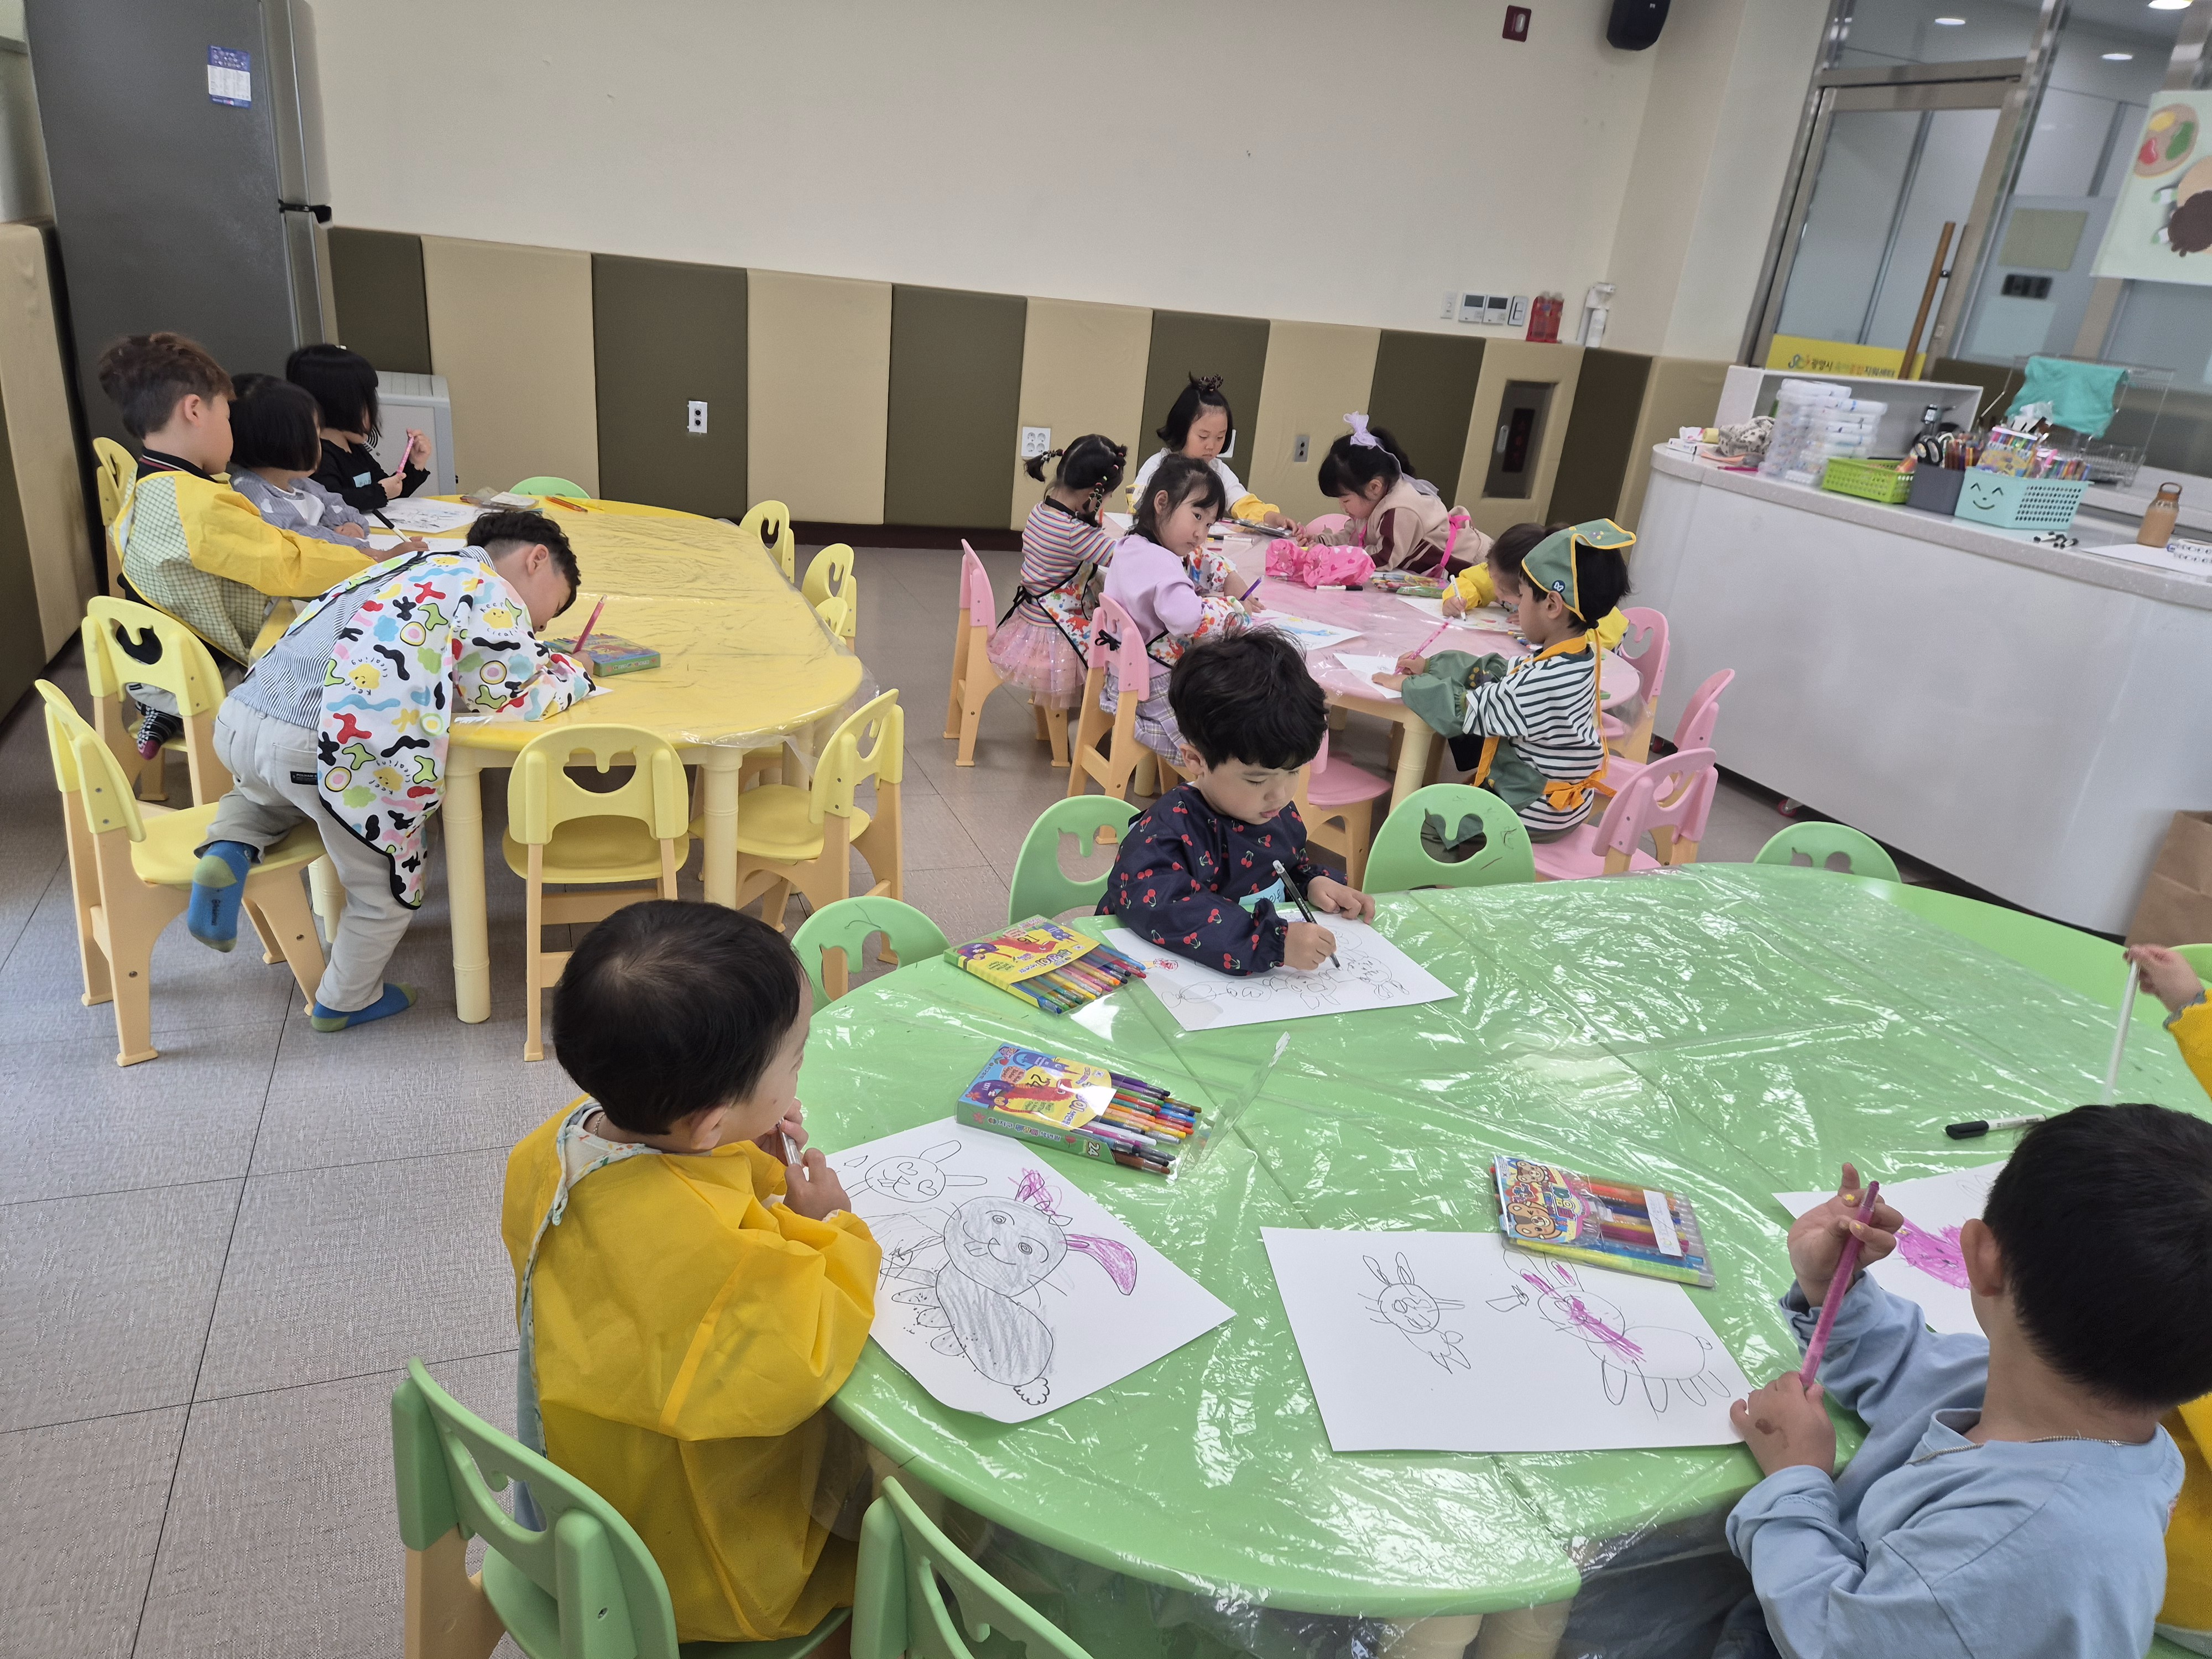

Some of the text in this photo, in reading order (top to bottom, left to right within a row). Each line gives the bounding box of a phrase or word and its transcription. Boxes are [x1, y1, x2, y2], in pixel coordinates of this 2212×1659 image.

[1025, 1073, 1051, 1088] 24
[998, 1120, 1014, 1129] 지구
[1040, 1131, 1061, 1142] 색연필
[1087, 1141, 1100, 1156] 24
